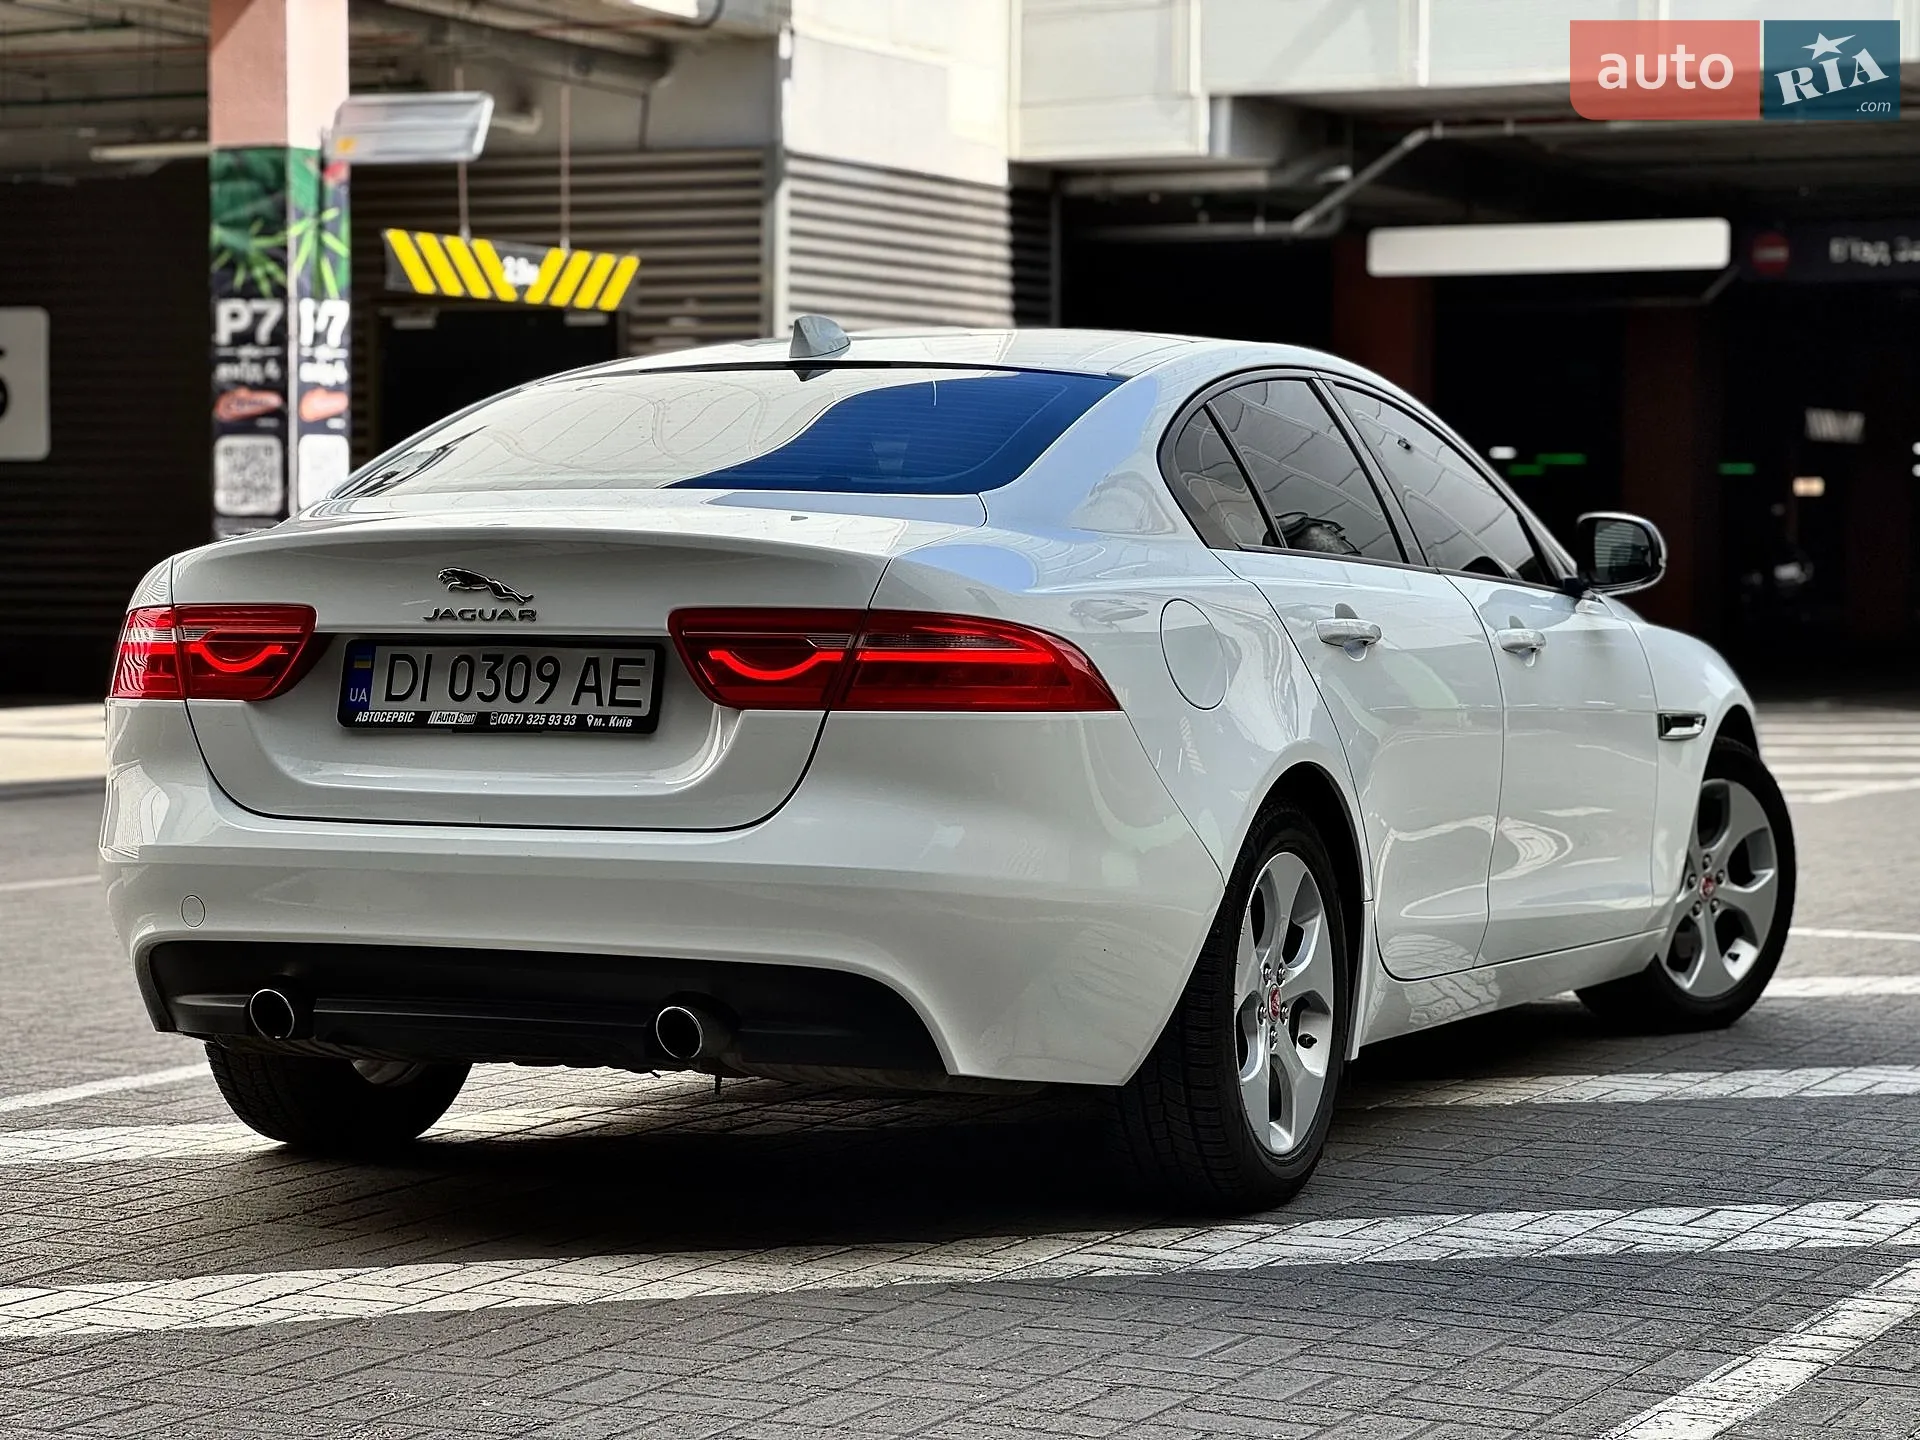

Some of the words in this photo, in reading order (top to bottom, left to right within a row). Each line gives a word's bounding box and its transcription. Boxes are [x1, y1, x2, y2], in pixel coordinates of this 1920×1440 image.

[215, 297, 284, 346] P7
[422, 607, 538, 623] JAGUAR
[384, 653, 433, 703] DI
[448, 654, 561, 705] 0309
[571, 657, 647, 708] AE
[350, 687, 368, 703] UA
[355, 711, 416, 723] АВТОСЕРВІС
[498, 713, 524, 726] (067)
[526, 714, 546, 725] 325
[548, 715, 561, 726] 93
[563, 715, 577, 726] 93
[609, 715, 633, 728] Київ
